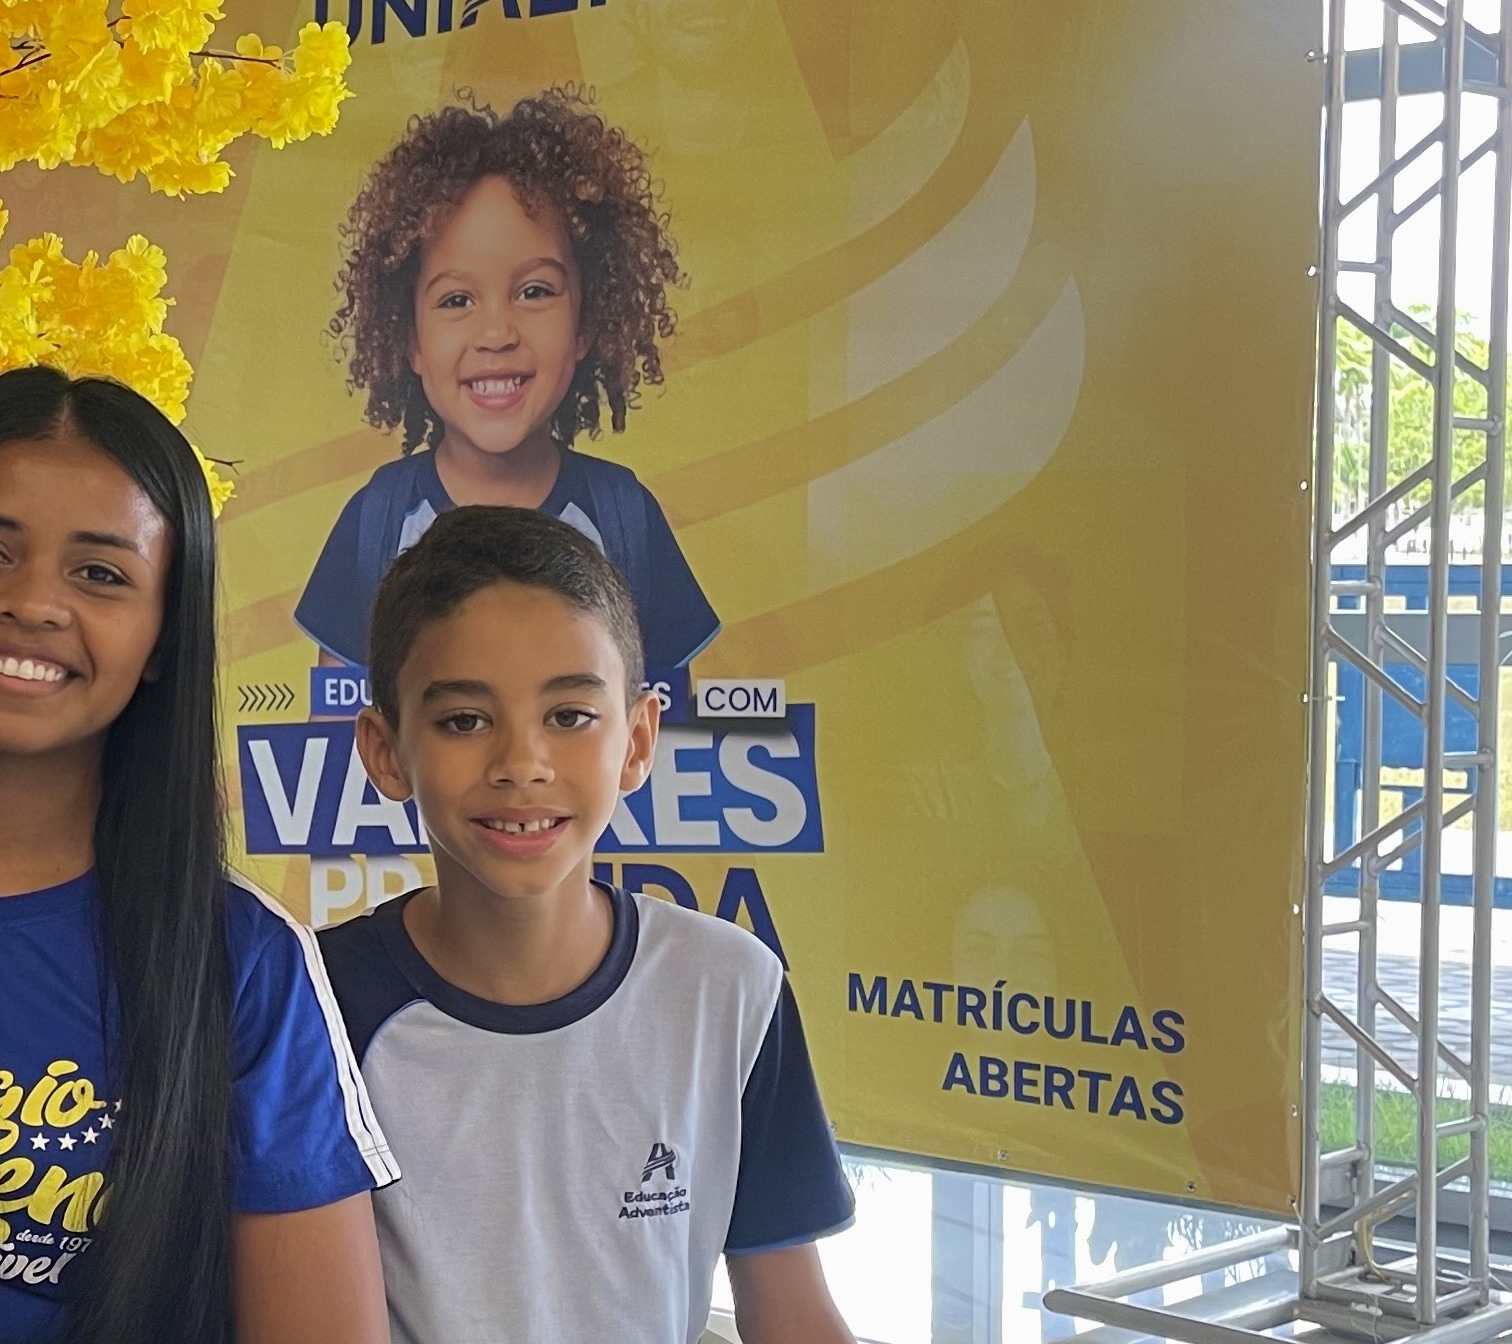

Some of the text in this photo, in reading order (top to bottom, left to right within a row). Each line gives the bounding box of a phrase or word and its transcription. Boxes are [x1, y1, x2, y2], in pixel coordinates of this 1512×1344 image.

[705, 687, 778, 712] COM
[848, 972, 1185, 1053] MATRÍCULAS
[942, 1052, 1184, 1125] ABERTAS
[624, 1186, 687, 1203] Educação
[618, 1200, 690, 1219] Adventista
[59, 1237, 93, 1253] 197
